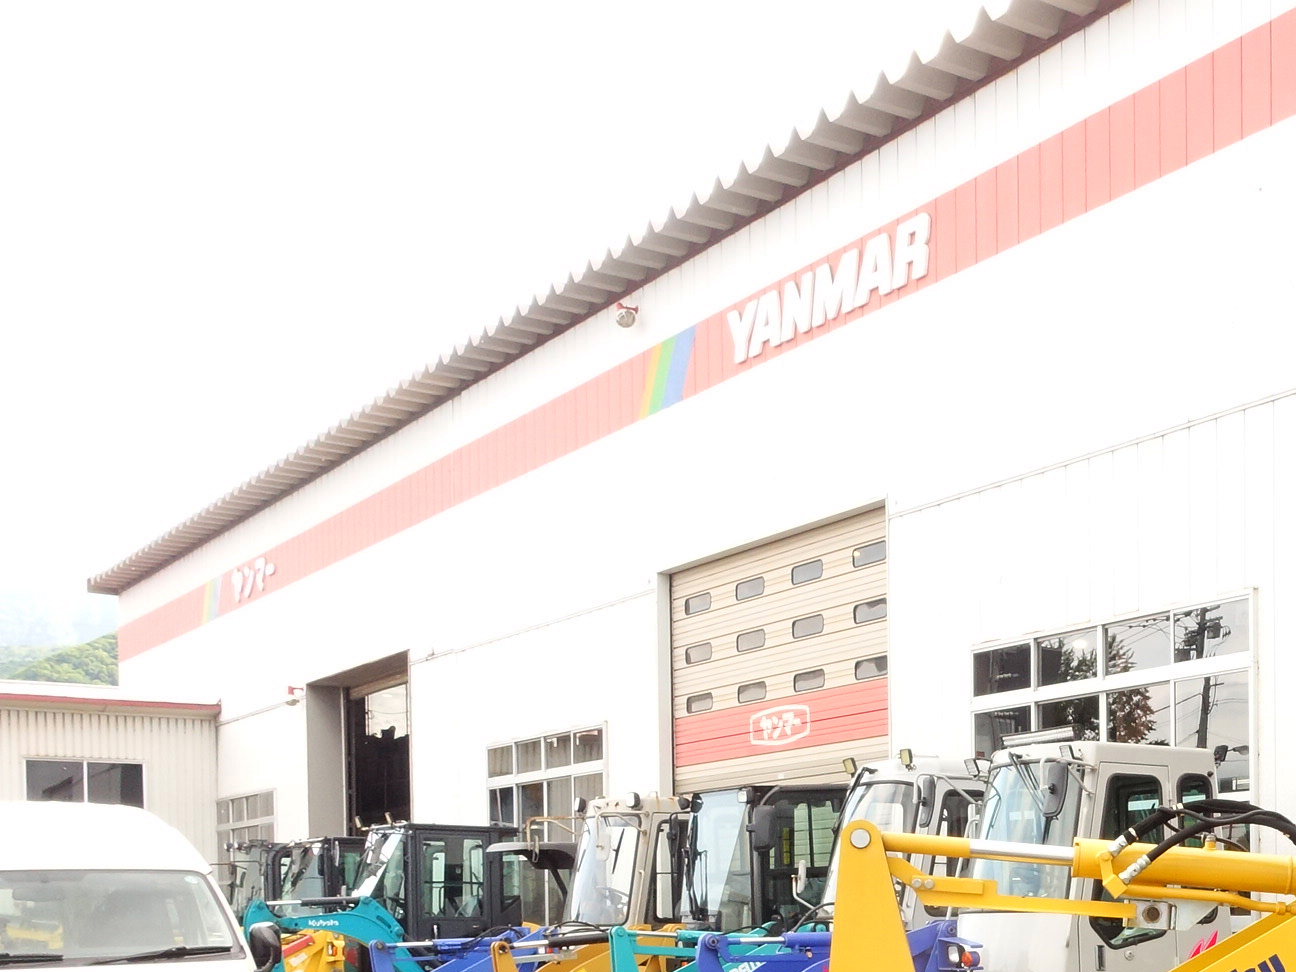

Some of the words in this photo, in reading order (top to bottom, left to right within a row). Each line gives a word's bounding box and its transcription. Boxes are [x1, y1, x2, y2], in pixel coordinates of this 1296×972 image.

[726, 212, 931, 364] YANMAR
[231, 556, 277, 604] ヤンマー
[760, 711, 801, 740] ヤンマー
